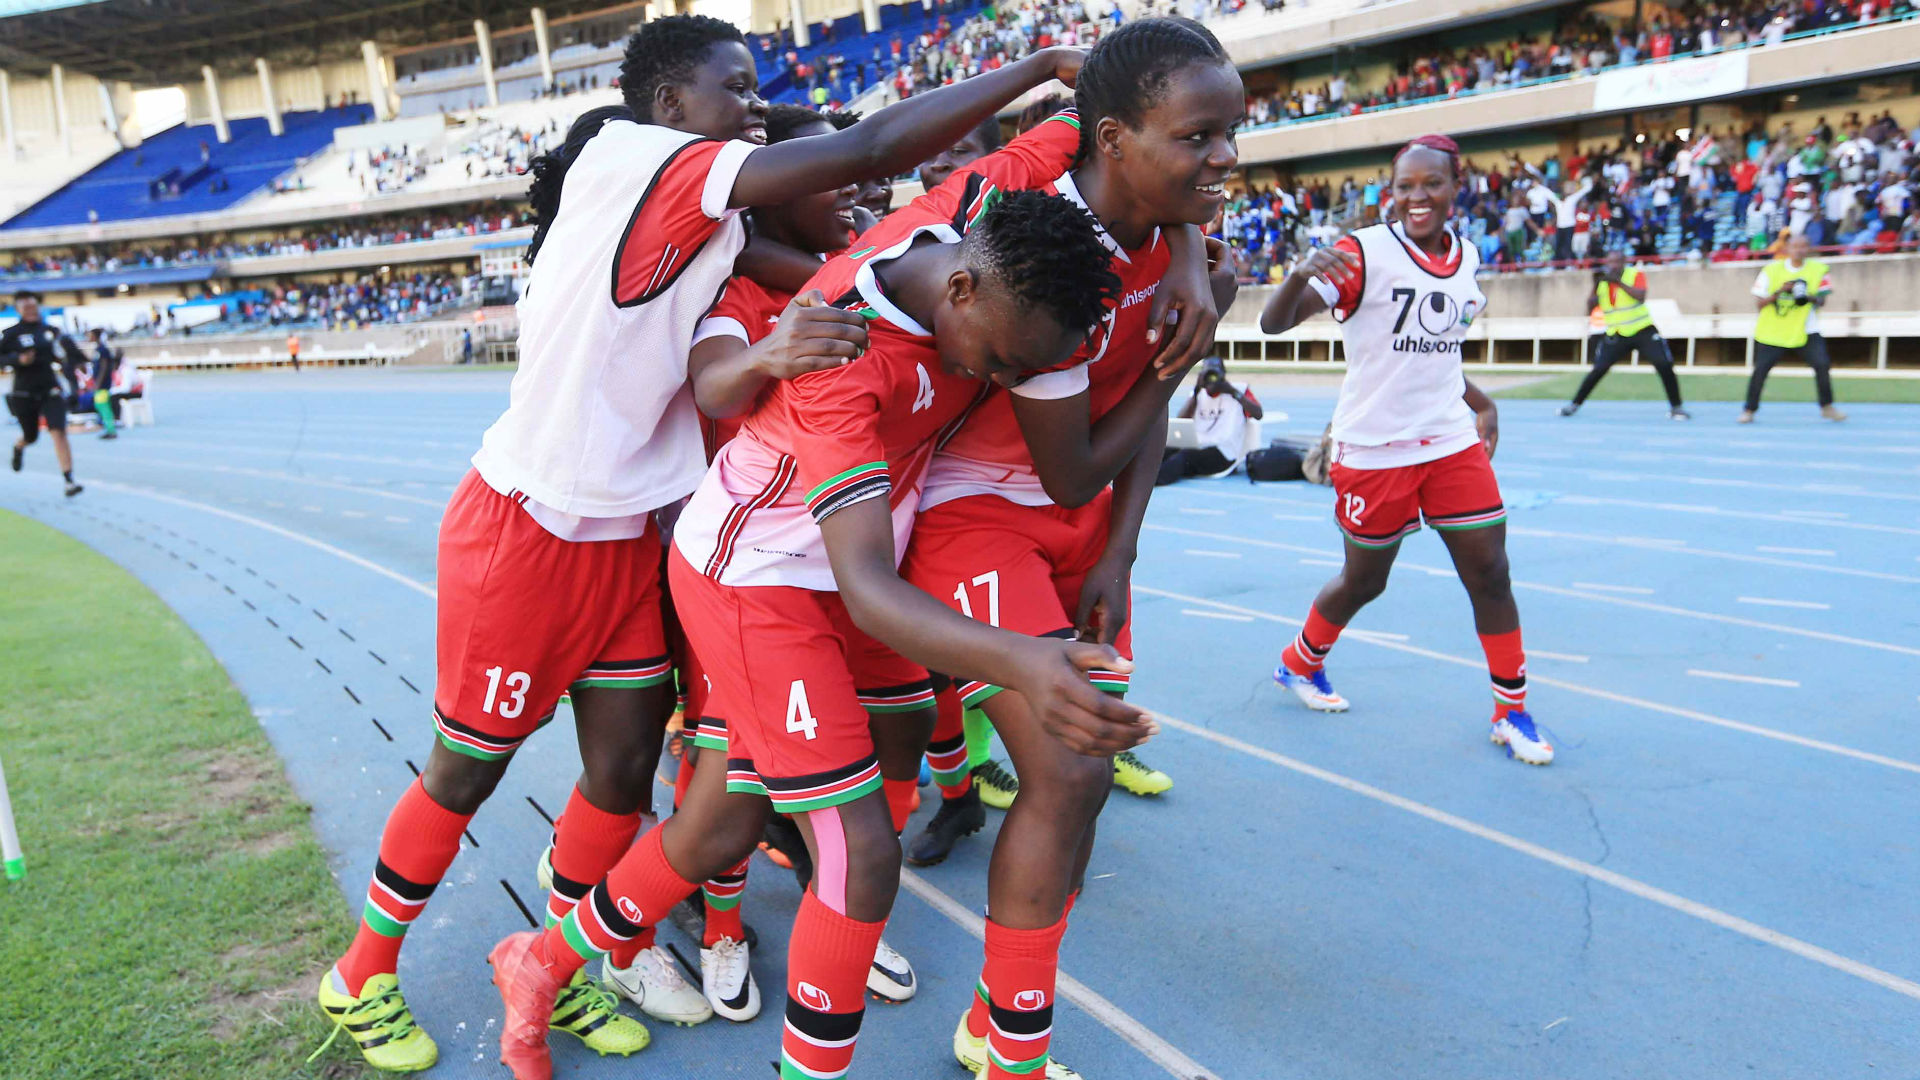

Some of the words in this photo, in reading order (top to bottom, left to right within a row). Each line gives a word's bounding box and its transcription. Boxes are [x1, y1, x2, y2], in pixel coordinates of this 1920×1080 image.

[912, 361, 935, 414] 4
[1343, 492, 1366, 527] 12
[953, 570, 1000, 628] 17
[482, 665, 532, 719] 13
[785, 679, 819, 741] 4
